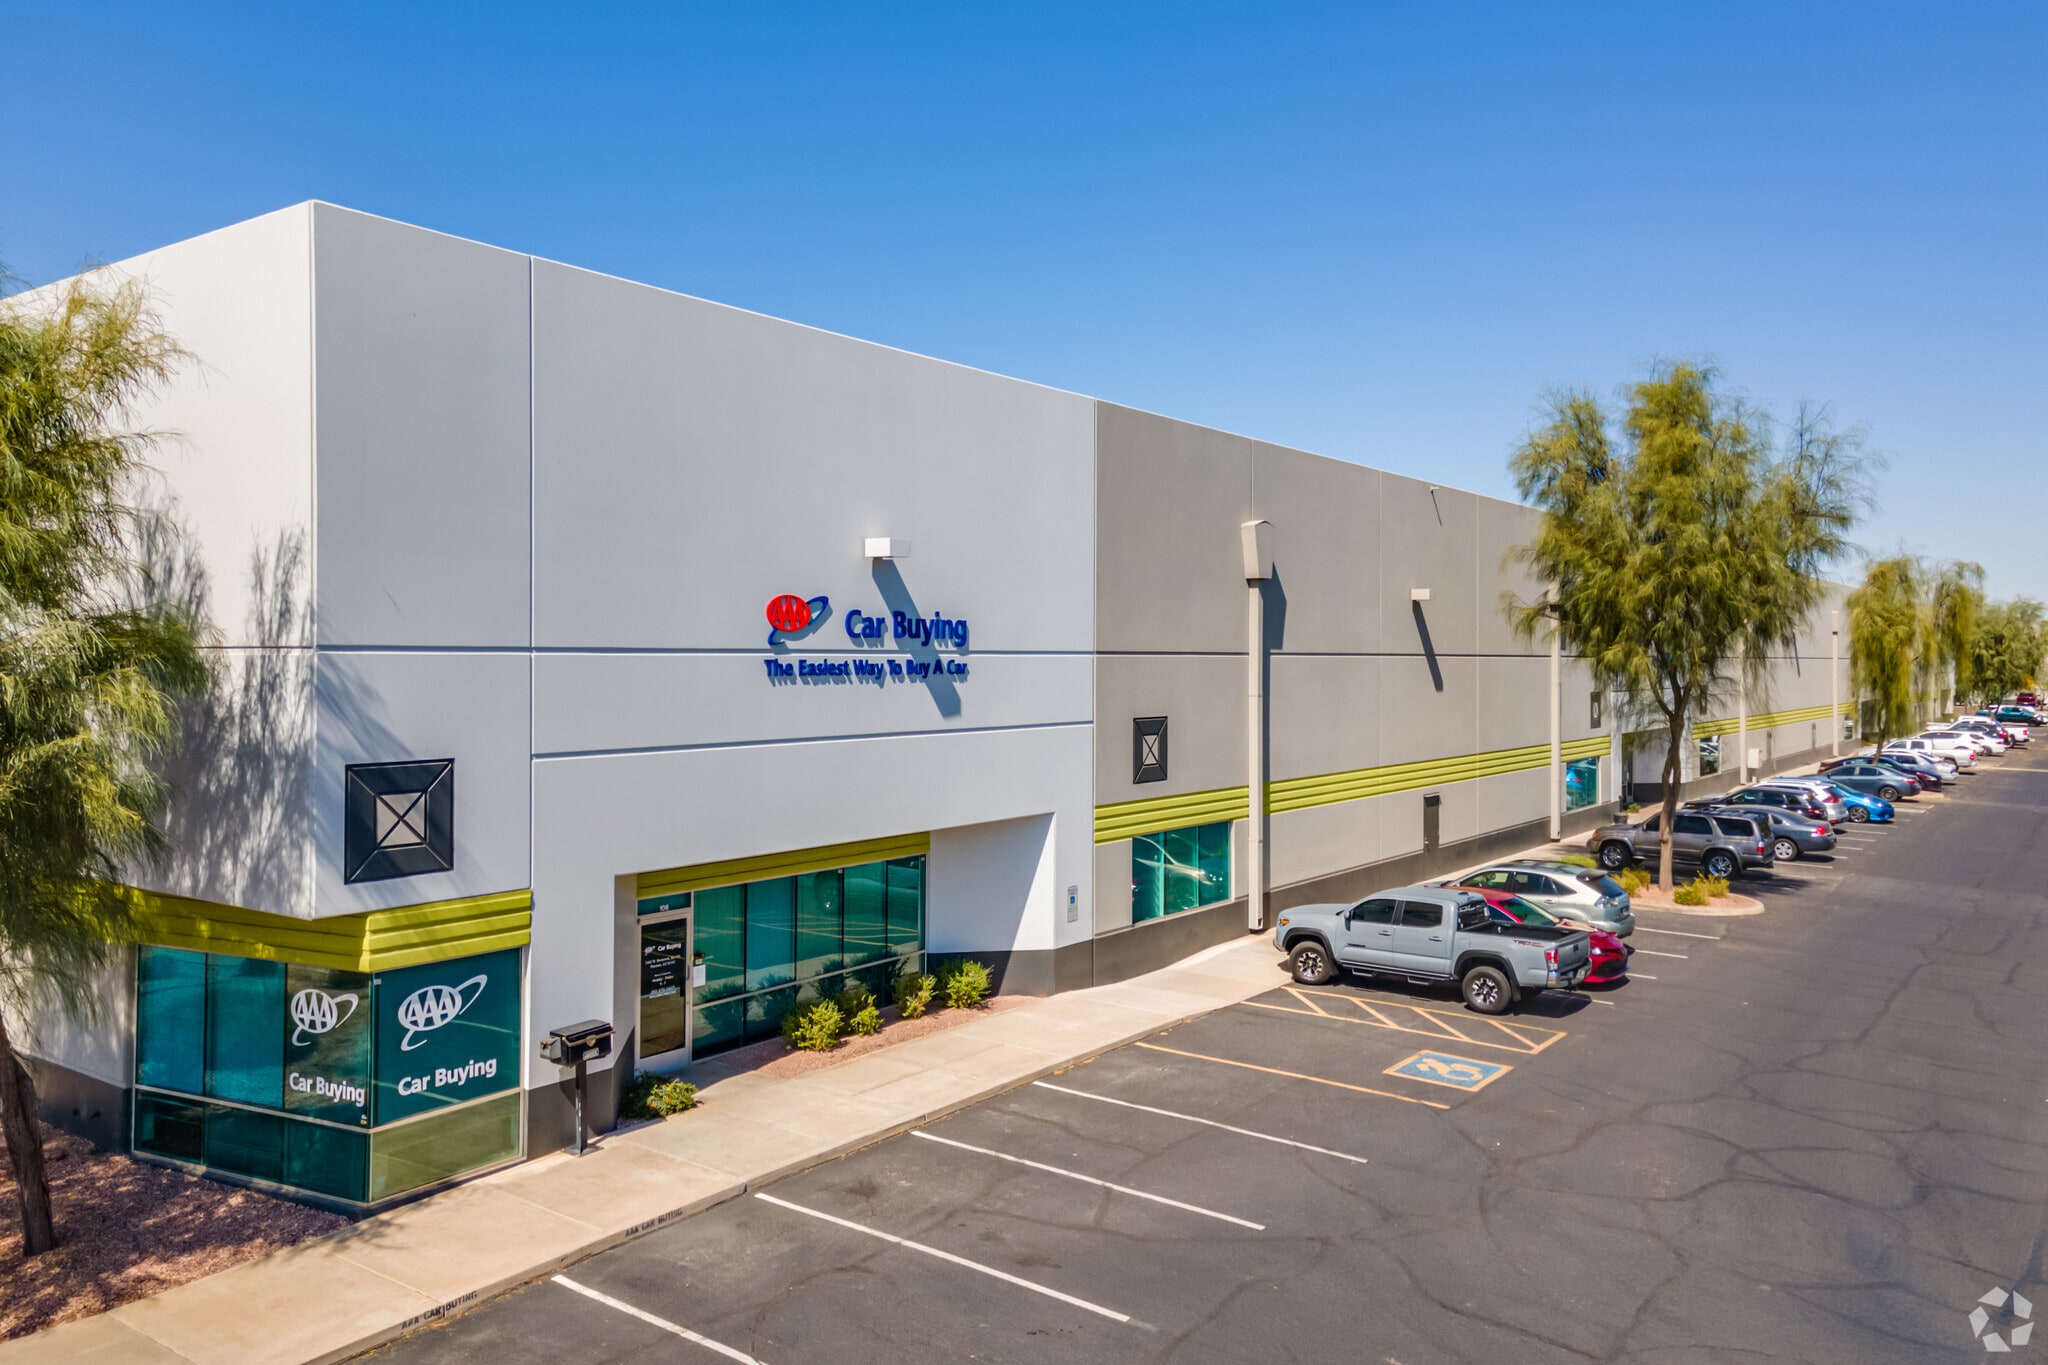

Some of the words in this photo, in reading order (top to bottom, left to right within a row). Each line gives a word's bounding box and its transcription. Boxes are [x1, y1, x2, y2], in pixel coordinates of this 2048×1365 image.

[768, 595, 809, 631] AAA
[845, 609, 885, 638] Car
[893, 611, 967, 647] Buying
[764, 659, 793, 676] The
[798, 659, 850, 676] Easiest
[853, 659, 884, 680] Way
[887, 659, 903, 676] To
[906, 659, 930, 679] Buy
[932, 660, 944, 675] A
[947, 659, 967, 675] Car
[294, 990, 336, 1032] AAA
[402, 986, 460, 1030] AAA
[289, 1073, 313, 1093] Car
[316, 1077, 365, 1107] Buying
[398, 1074, 431, 1096] Car
[435, 1058, 497, 1087] Buying
[402, 1316, 419, 1329] AAA
[445, 1290, 477, 1311] BUYING
